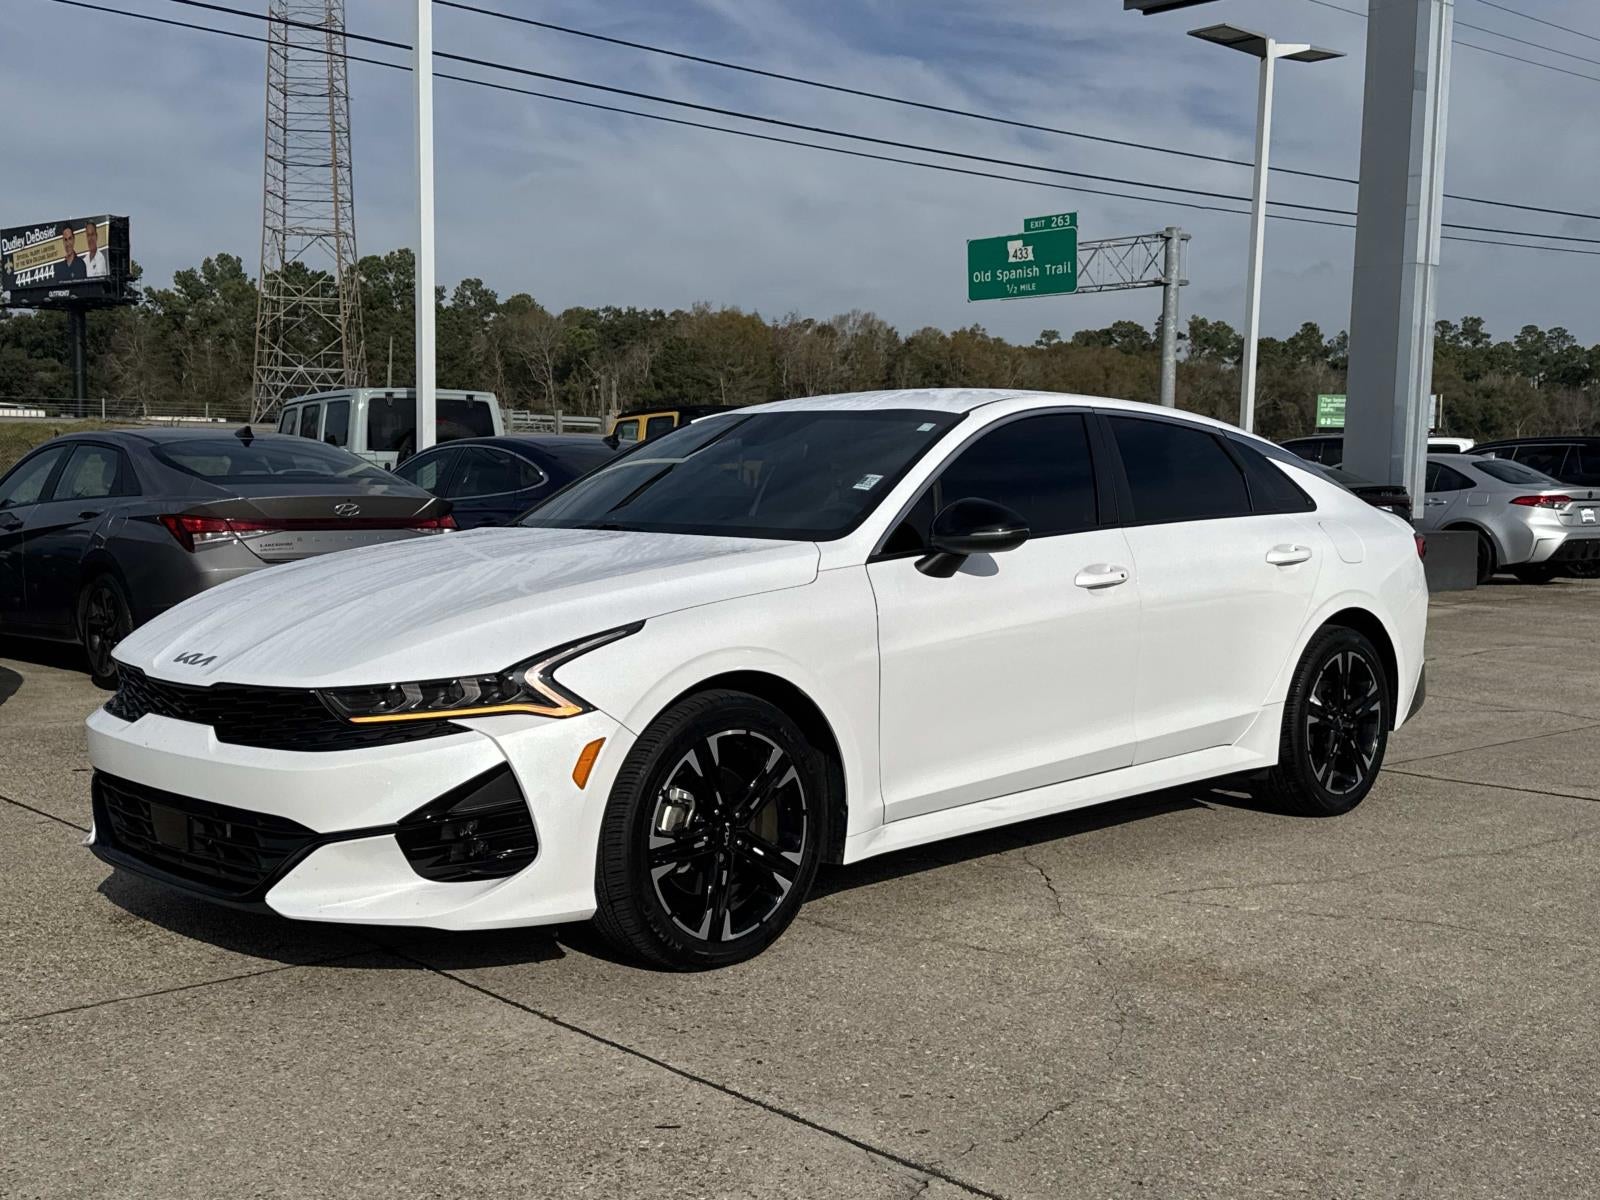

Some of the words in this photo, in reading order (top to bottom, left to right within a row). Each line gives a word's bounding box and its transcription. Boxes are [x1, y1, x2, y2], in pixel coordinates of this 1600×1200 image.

[1030, 220, 1046, 229] EXIT
[1051, 215, 1070, 227] 263
[2, 234, 25, 252] Dudley
[25, 226, 56, 243] DeBosier
[1012, 247, 1029, 260] 433
[15, 264, 55, 287] 444-4444
[973, 271, 991, 283] Old
[996, 265, 1040, 283] Spanish
[1045, 261, 1072, 276] Trail
[1020, 283, 1036, 291] MILE
[173, 651, 218, 667] KIA
